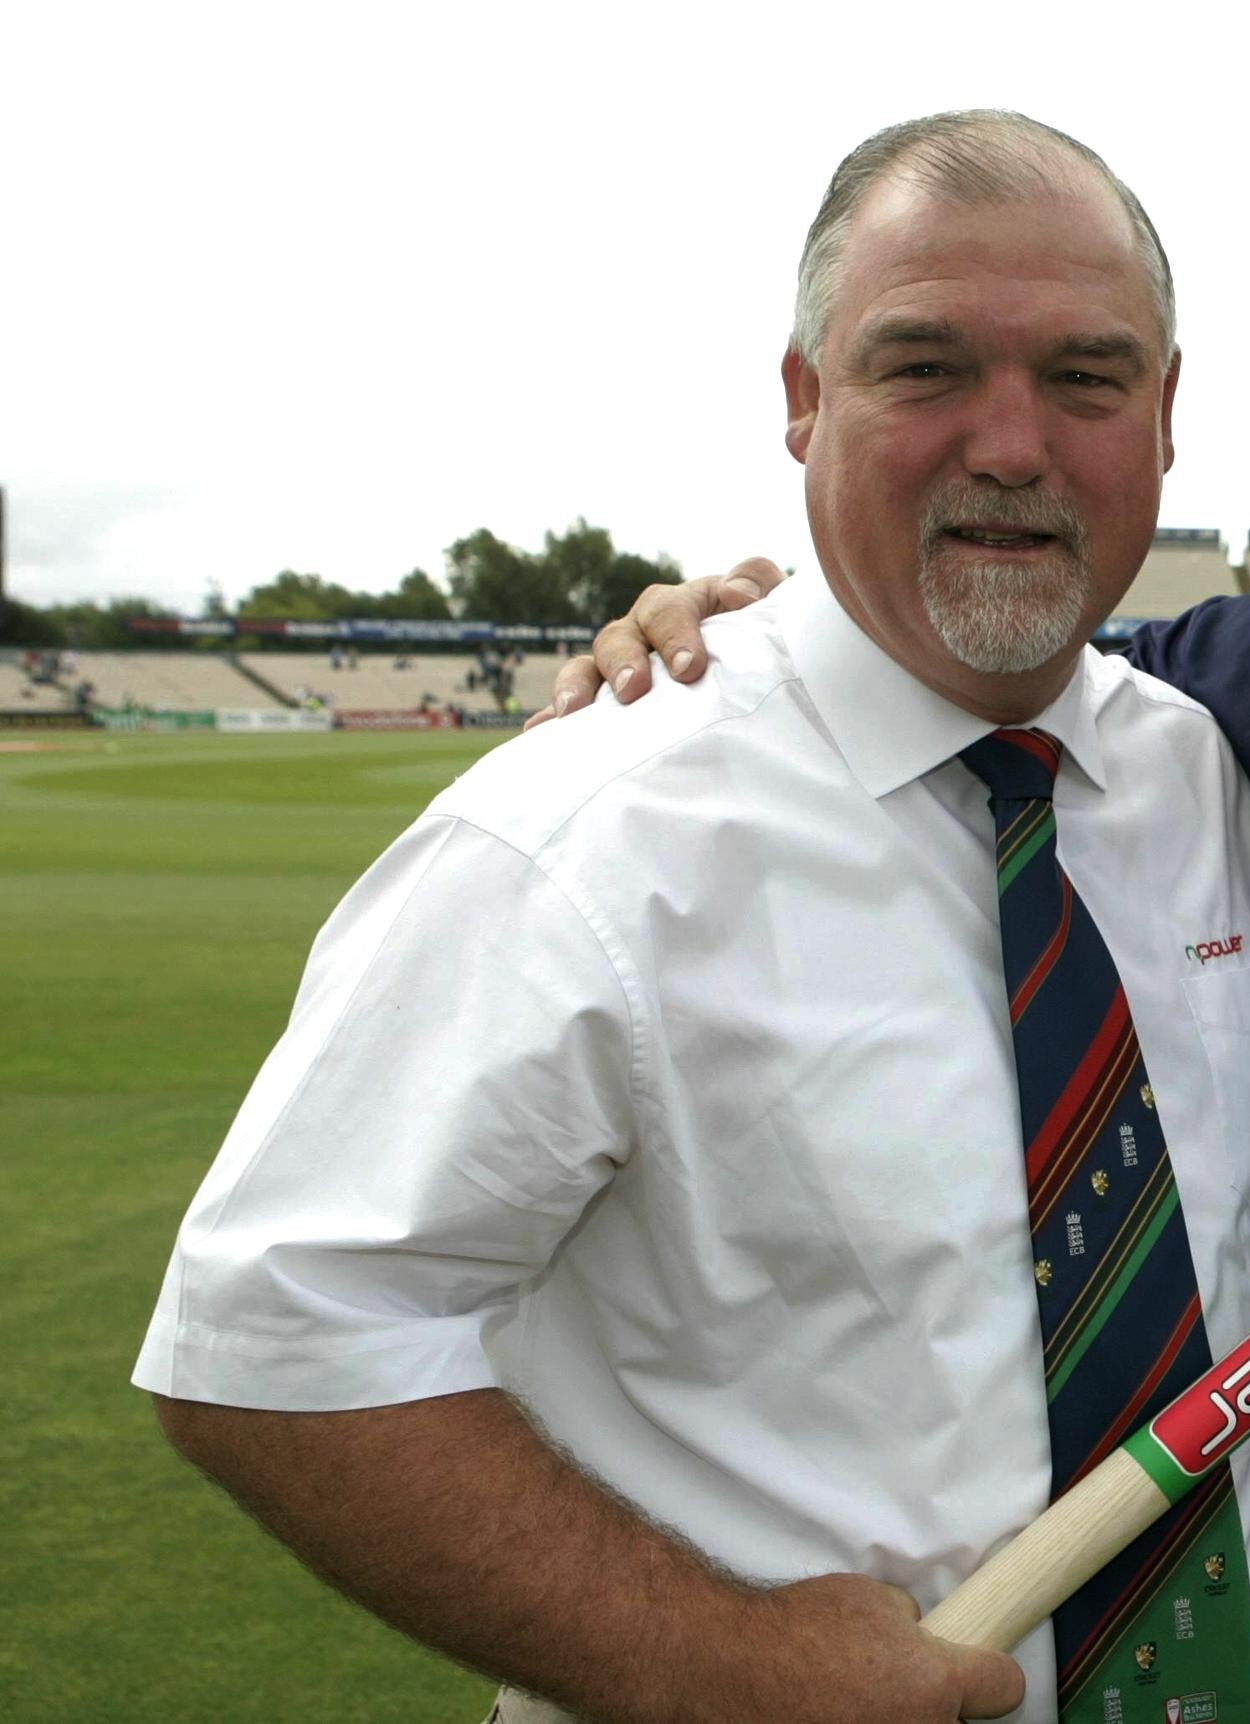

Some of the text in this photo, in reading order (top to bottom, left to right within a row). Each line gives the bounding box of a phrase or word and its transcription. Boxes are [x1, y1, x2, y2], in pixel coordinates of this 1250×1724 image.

[1185, 935, 1243, 966] npower
[1123, 1158, 1139, 1167] ECB
[1069, 1246, 1085, 1256] ECB
[1176, 1631, 1194, 1640] ECB
[1184, 1704, 1213, 1715] Ashes
